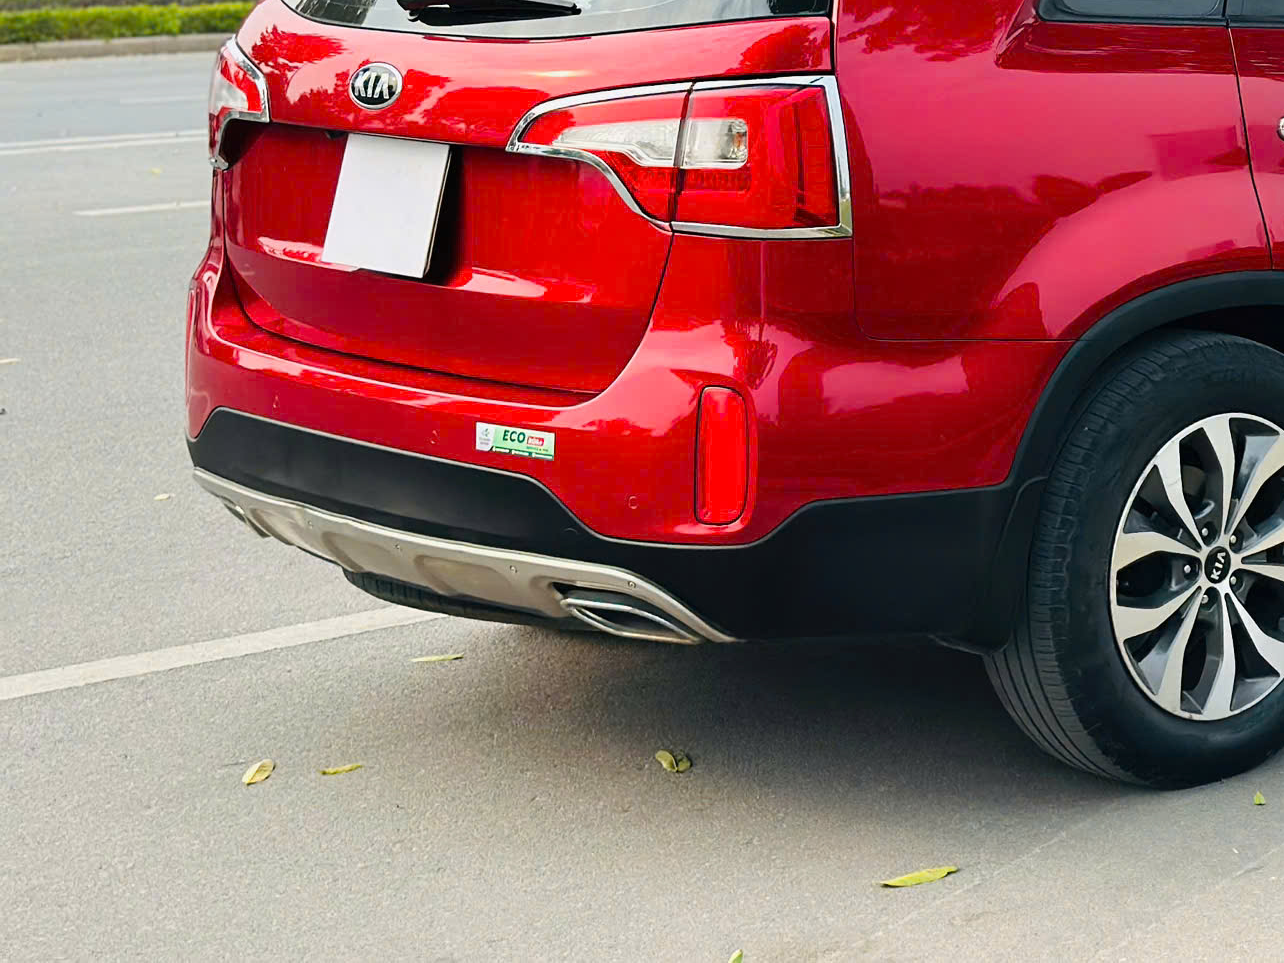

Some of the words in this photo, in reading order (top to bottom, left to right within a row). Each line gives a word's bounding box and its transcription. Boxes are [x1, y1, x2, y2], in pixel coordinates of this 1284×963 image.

[354, 71, 389, 99] KIA
[502, 429, 526, 443] ECO
[1210, 552, 1226, 580] KIA
